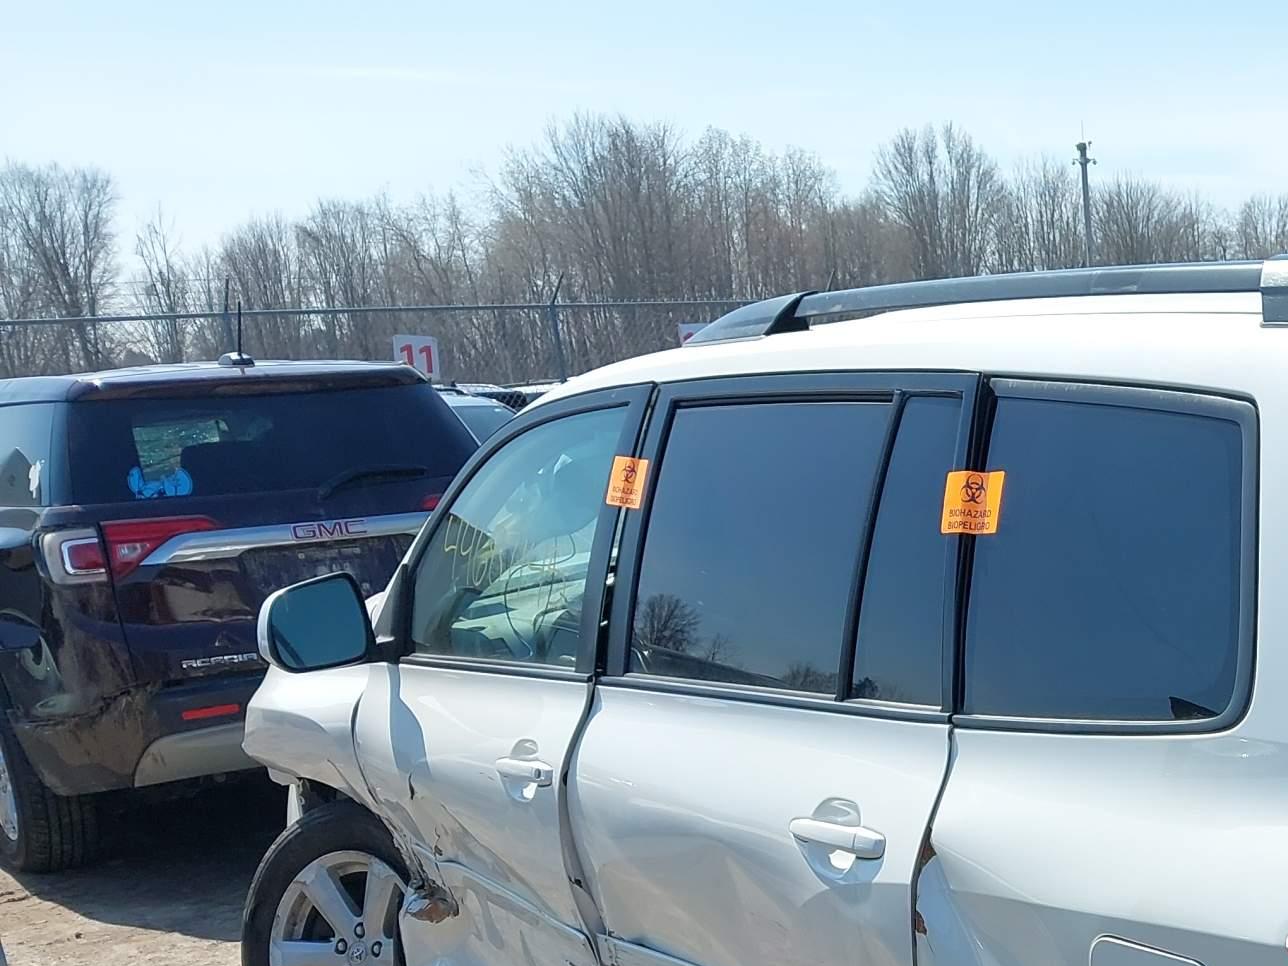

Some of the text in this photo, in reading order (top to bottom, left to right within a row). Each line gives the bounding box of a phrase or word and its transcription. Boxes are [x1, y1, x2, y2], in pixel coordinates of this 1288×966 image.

[400, 344, 433, 374] 11
[949, 508, 992, 518] BIOHAZARD
[292, 519, 368, 540] GMC
[947, 520, 991, 531] BIOPELIGRO
